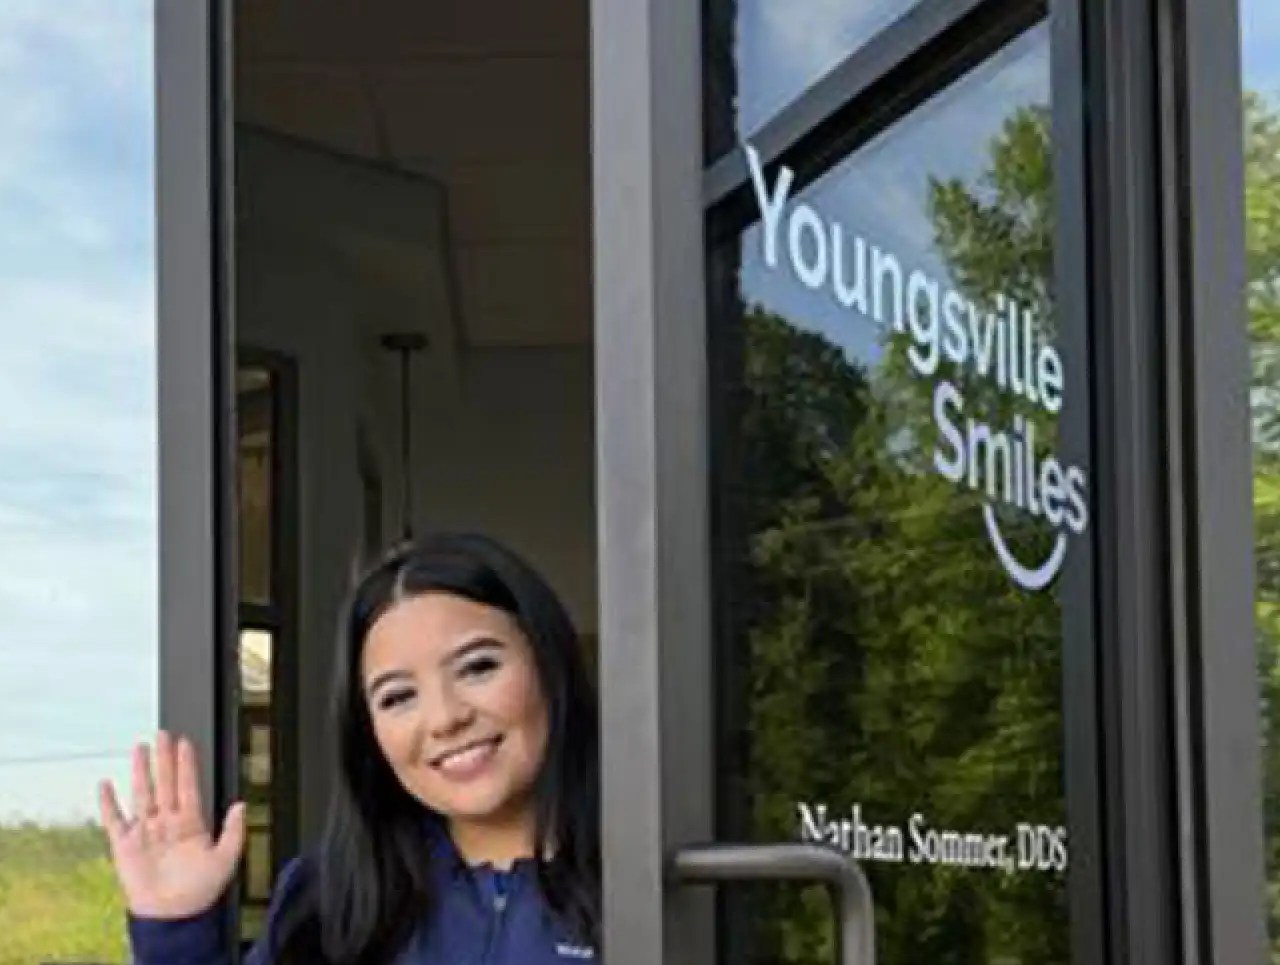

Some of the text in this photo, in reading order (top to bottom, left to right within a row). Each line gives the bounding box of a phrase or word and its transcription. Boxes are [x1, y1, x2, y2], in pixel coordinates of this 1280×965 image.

[744, 144, 1064, 411] Youngsville
[933, 380, 1087, 534] Smiles
[798, 802, 1067, 874] Nathan Sommer, DDS
